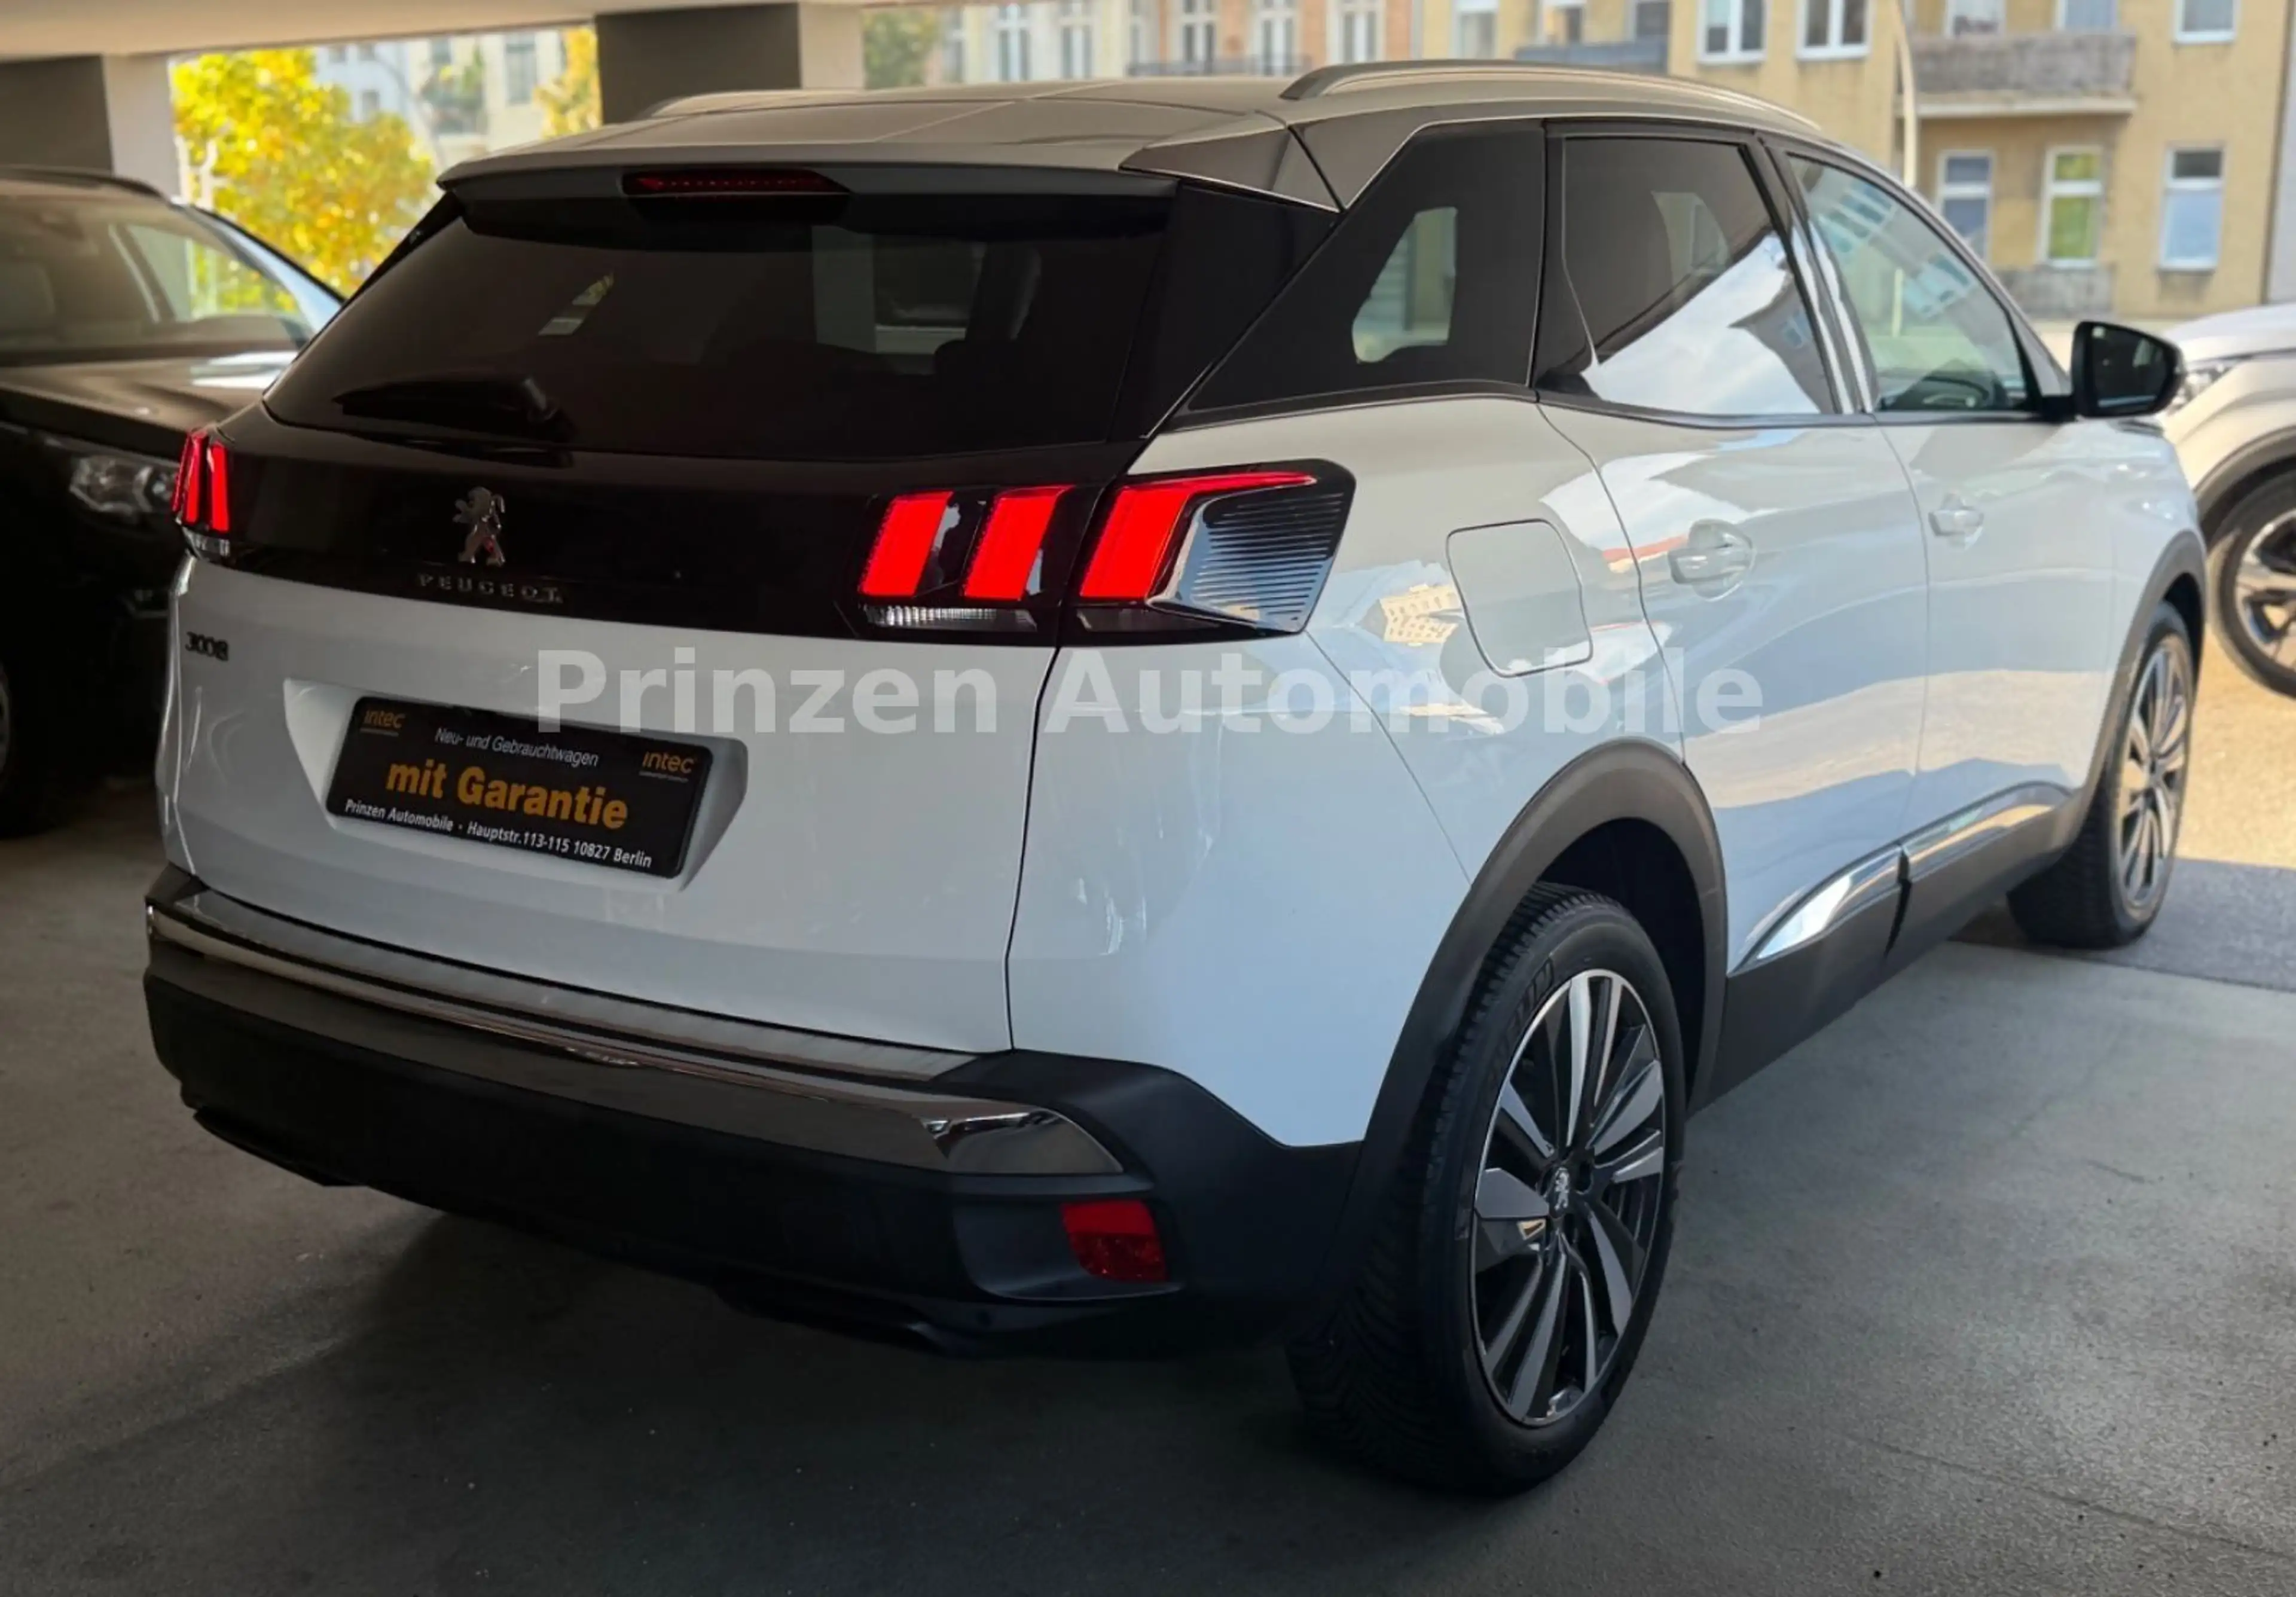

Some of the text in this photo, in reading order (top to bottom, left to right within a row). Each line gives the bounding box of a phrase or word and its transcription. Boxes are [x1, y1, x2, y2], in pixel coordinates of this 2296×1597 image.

[417, 573, 562, 603] PEUGEOT
[185, 631, 230, 662] 3008
[364, 709, 406, 729] intec
[434, 726, 600, 768] Neu- und Gebrauchtwagen
[641, 750, 695, 774] intec
[385, 758, 628, 830] mit Garantie
[344, 798, 386, 819] Prinzen
[387, 807, 454, 832] Automobile
[573, 840, 611, 860] 10827
[612, 847, 652, 868] Berlin
